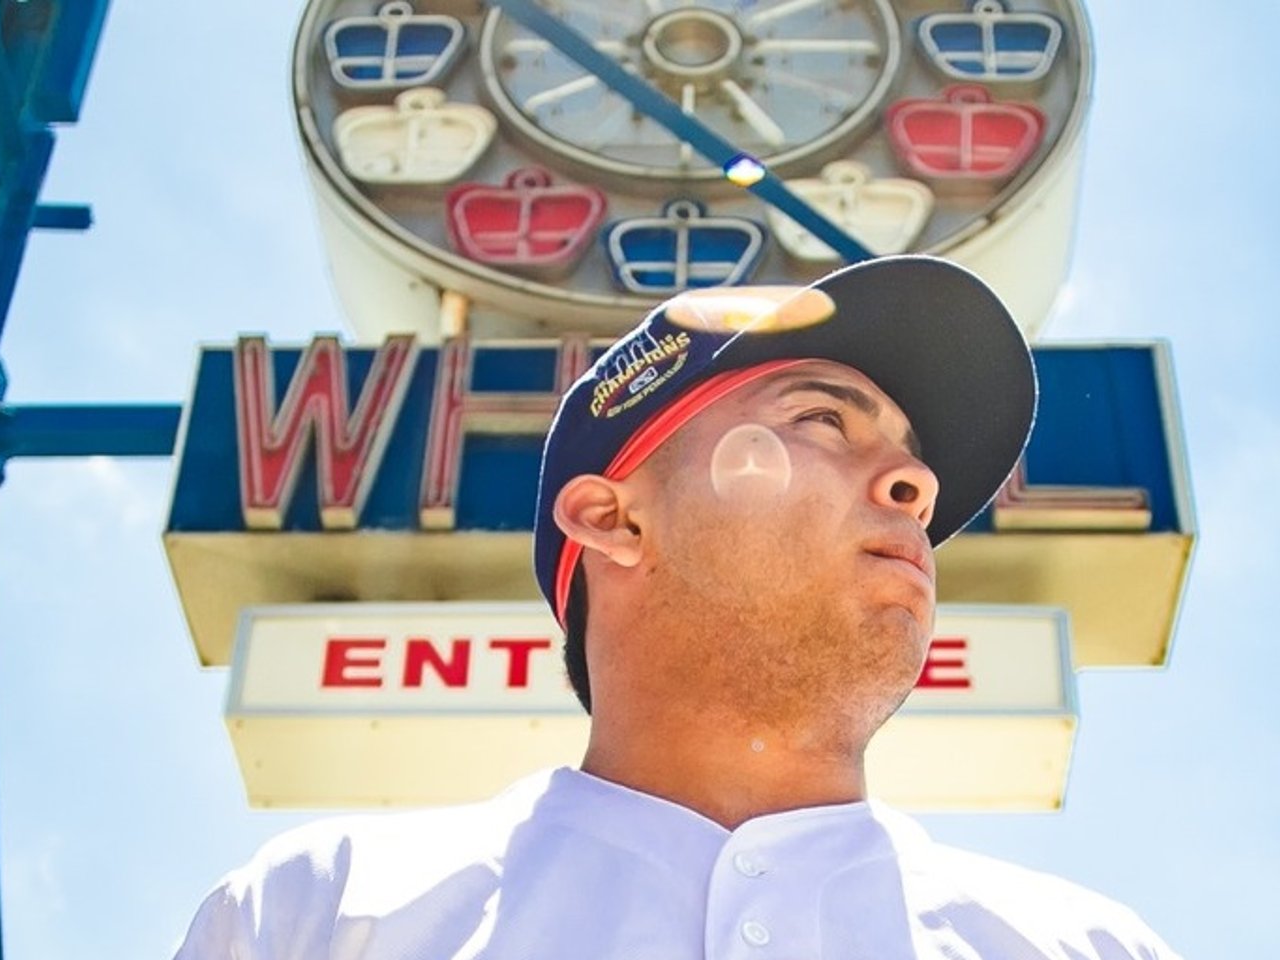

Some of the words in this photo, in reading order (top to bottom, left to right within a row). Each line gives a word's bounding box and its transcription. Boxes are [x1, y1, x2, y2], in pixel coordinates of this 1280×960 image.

[590, 332, 690, 417] CHAMPIONS
[234, 334, 1151, 530] WHL
[321, 638, 970, 689] ENTE
